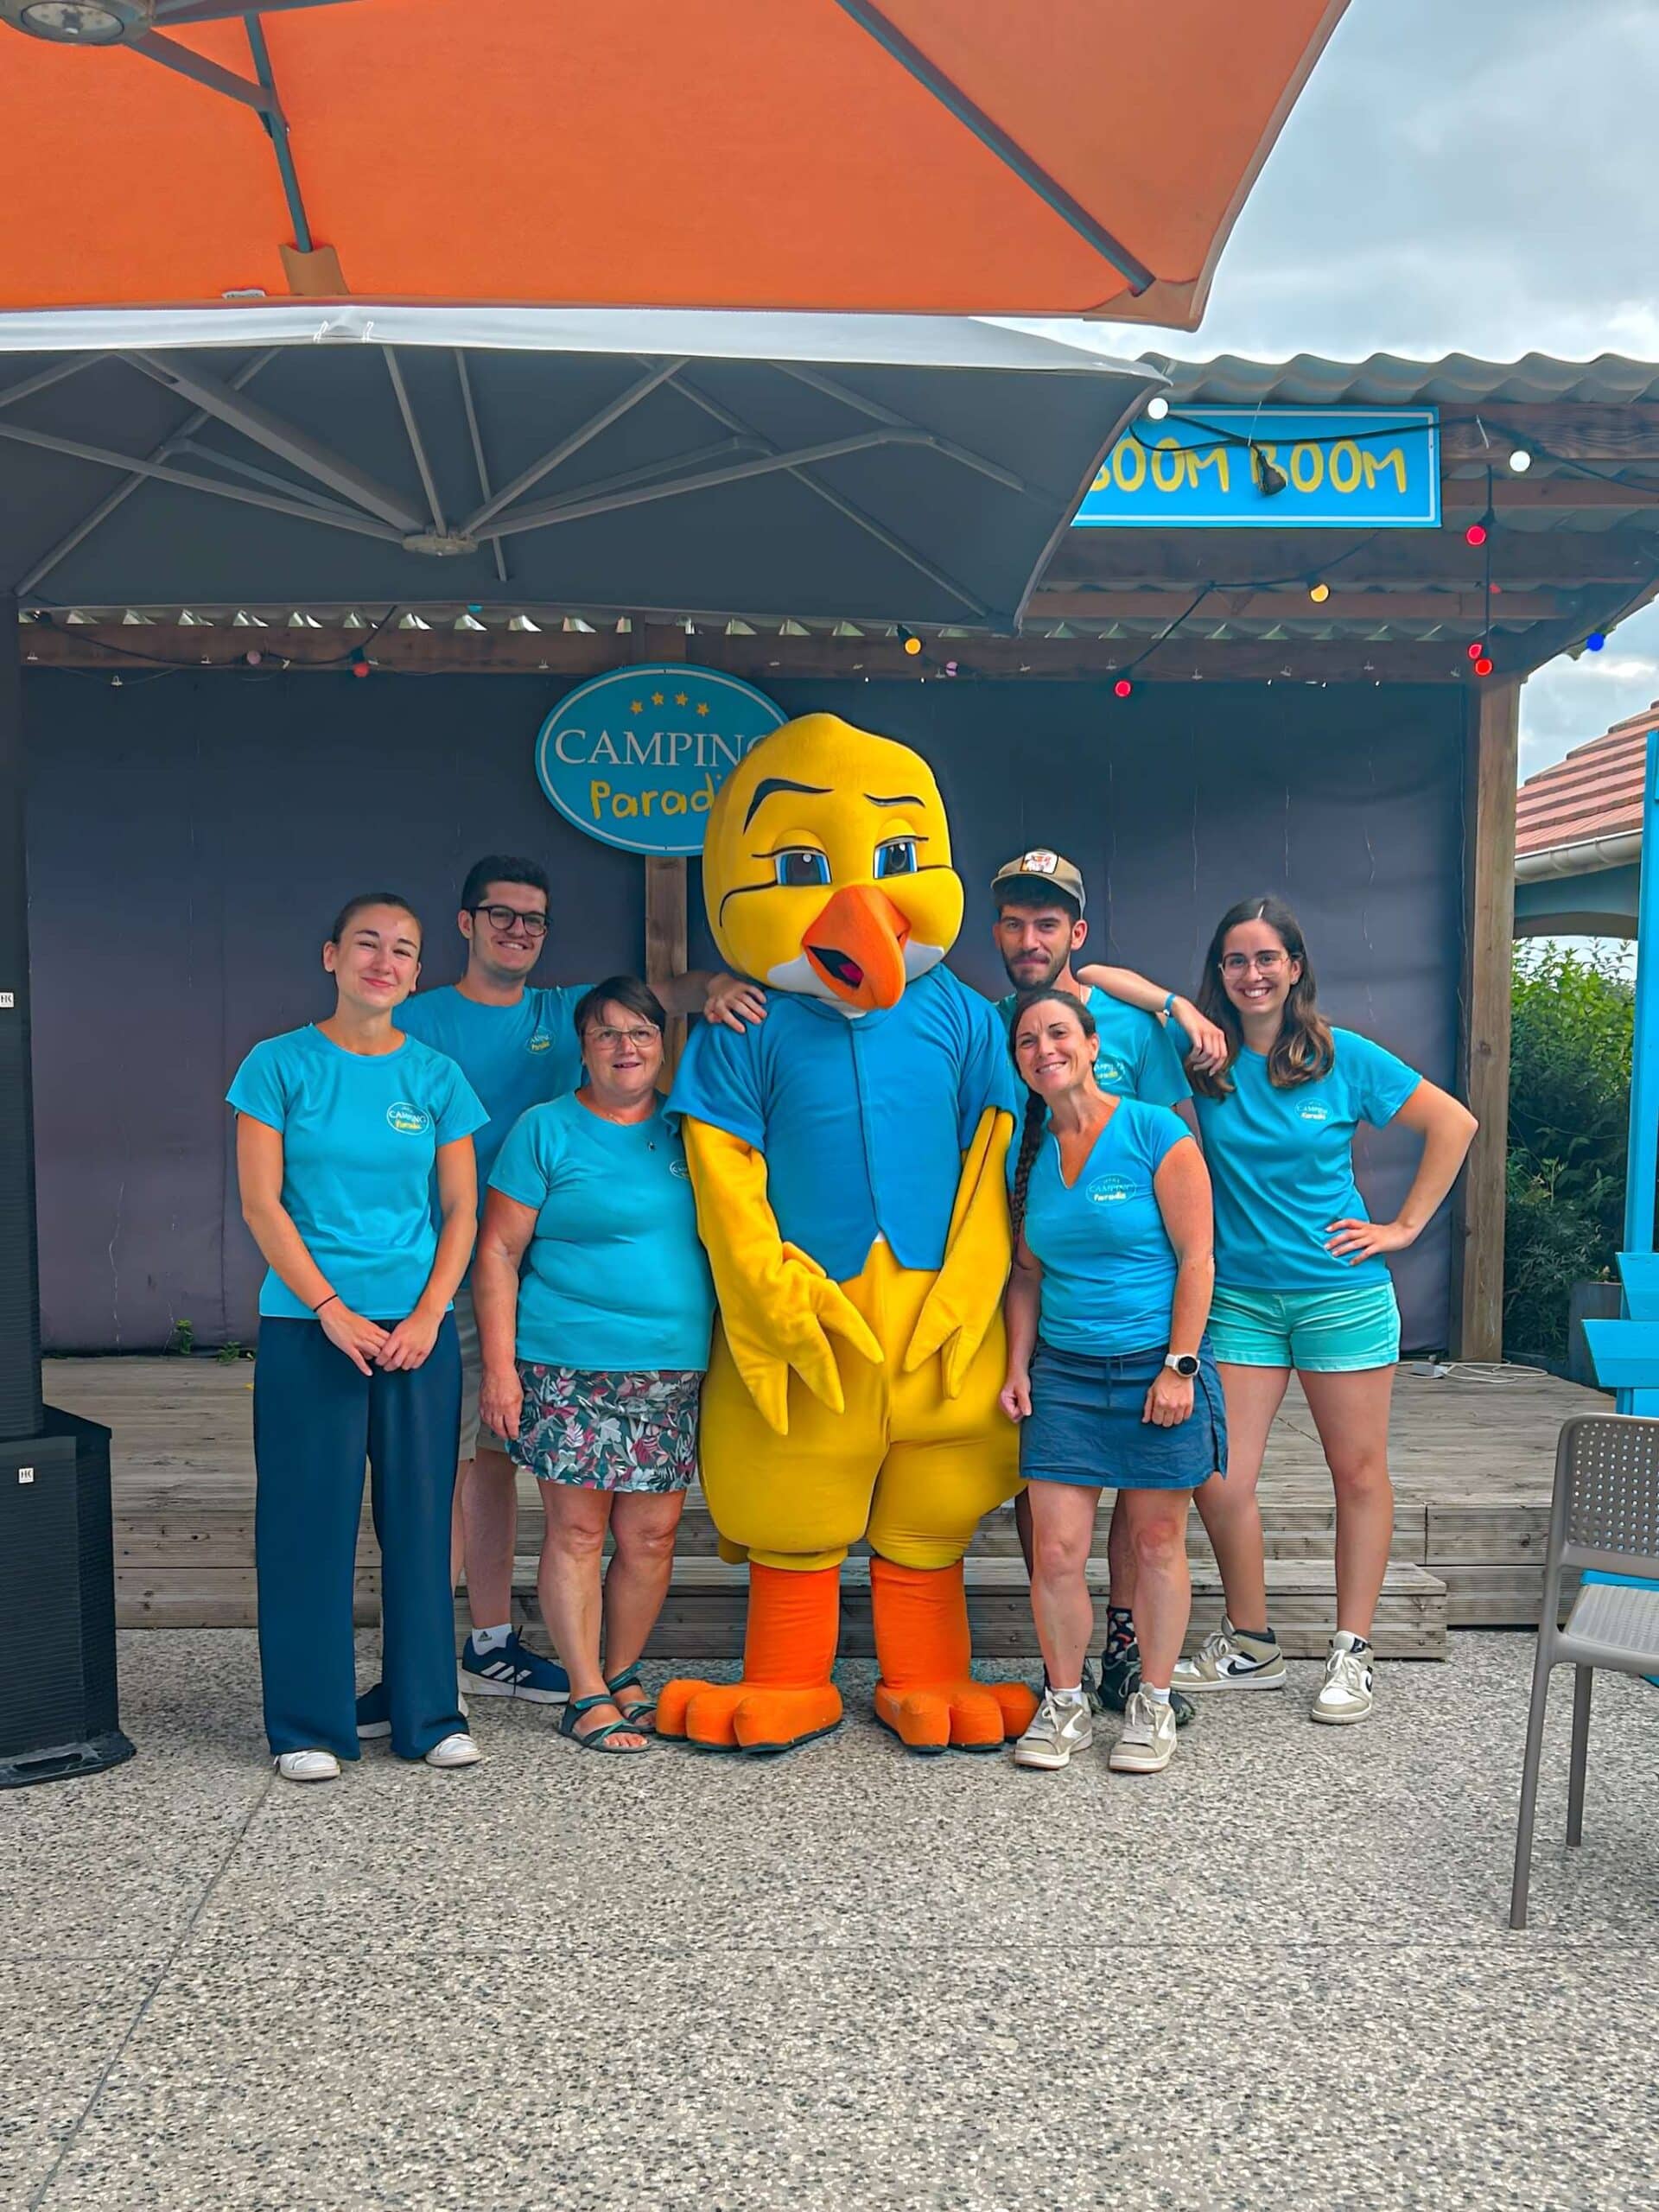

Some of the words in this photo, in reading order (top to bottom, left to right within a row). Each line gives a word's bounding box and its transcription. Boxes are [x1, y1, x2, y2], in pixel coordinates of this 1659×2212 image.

[1090, 437, 1230, 493] OOM
[555, 729, 767, 767] CAMPIN
[590, 772, 722, 819] Parad
